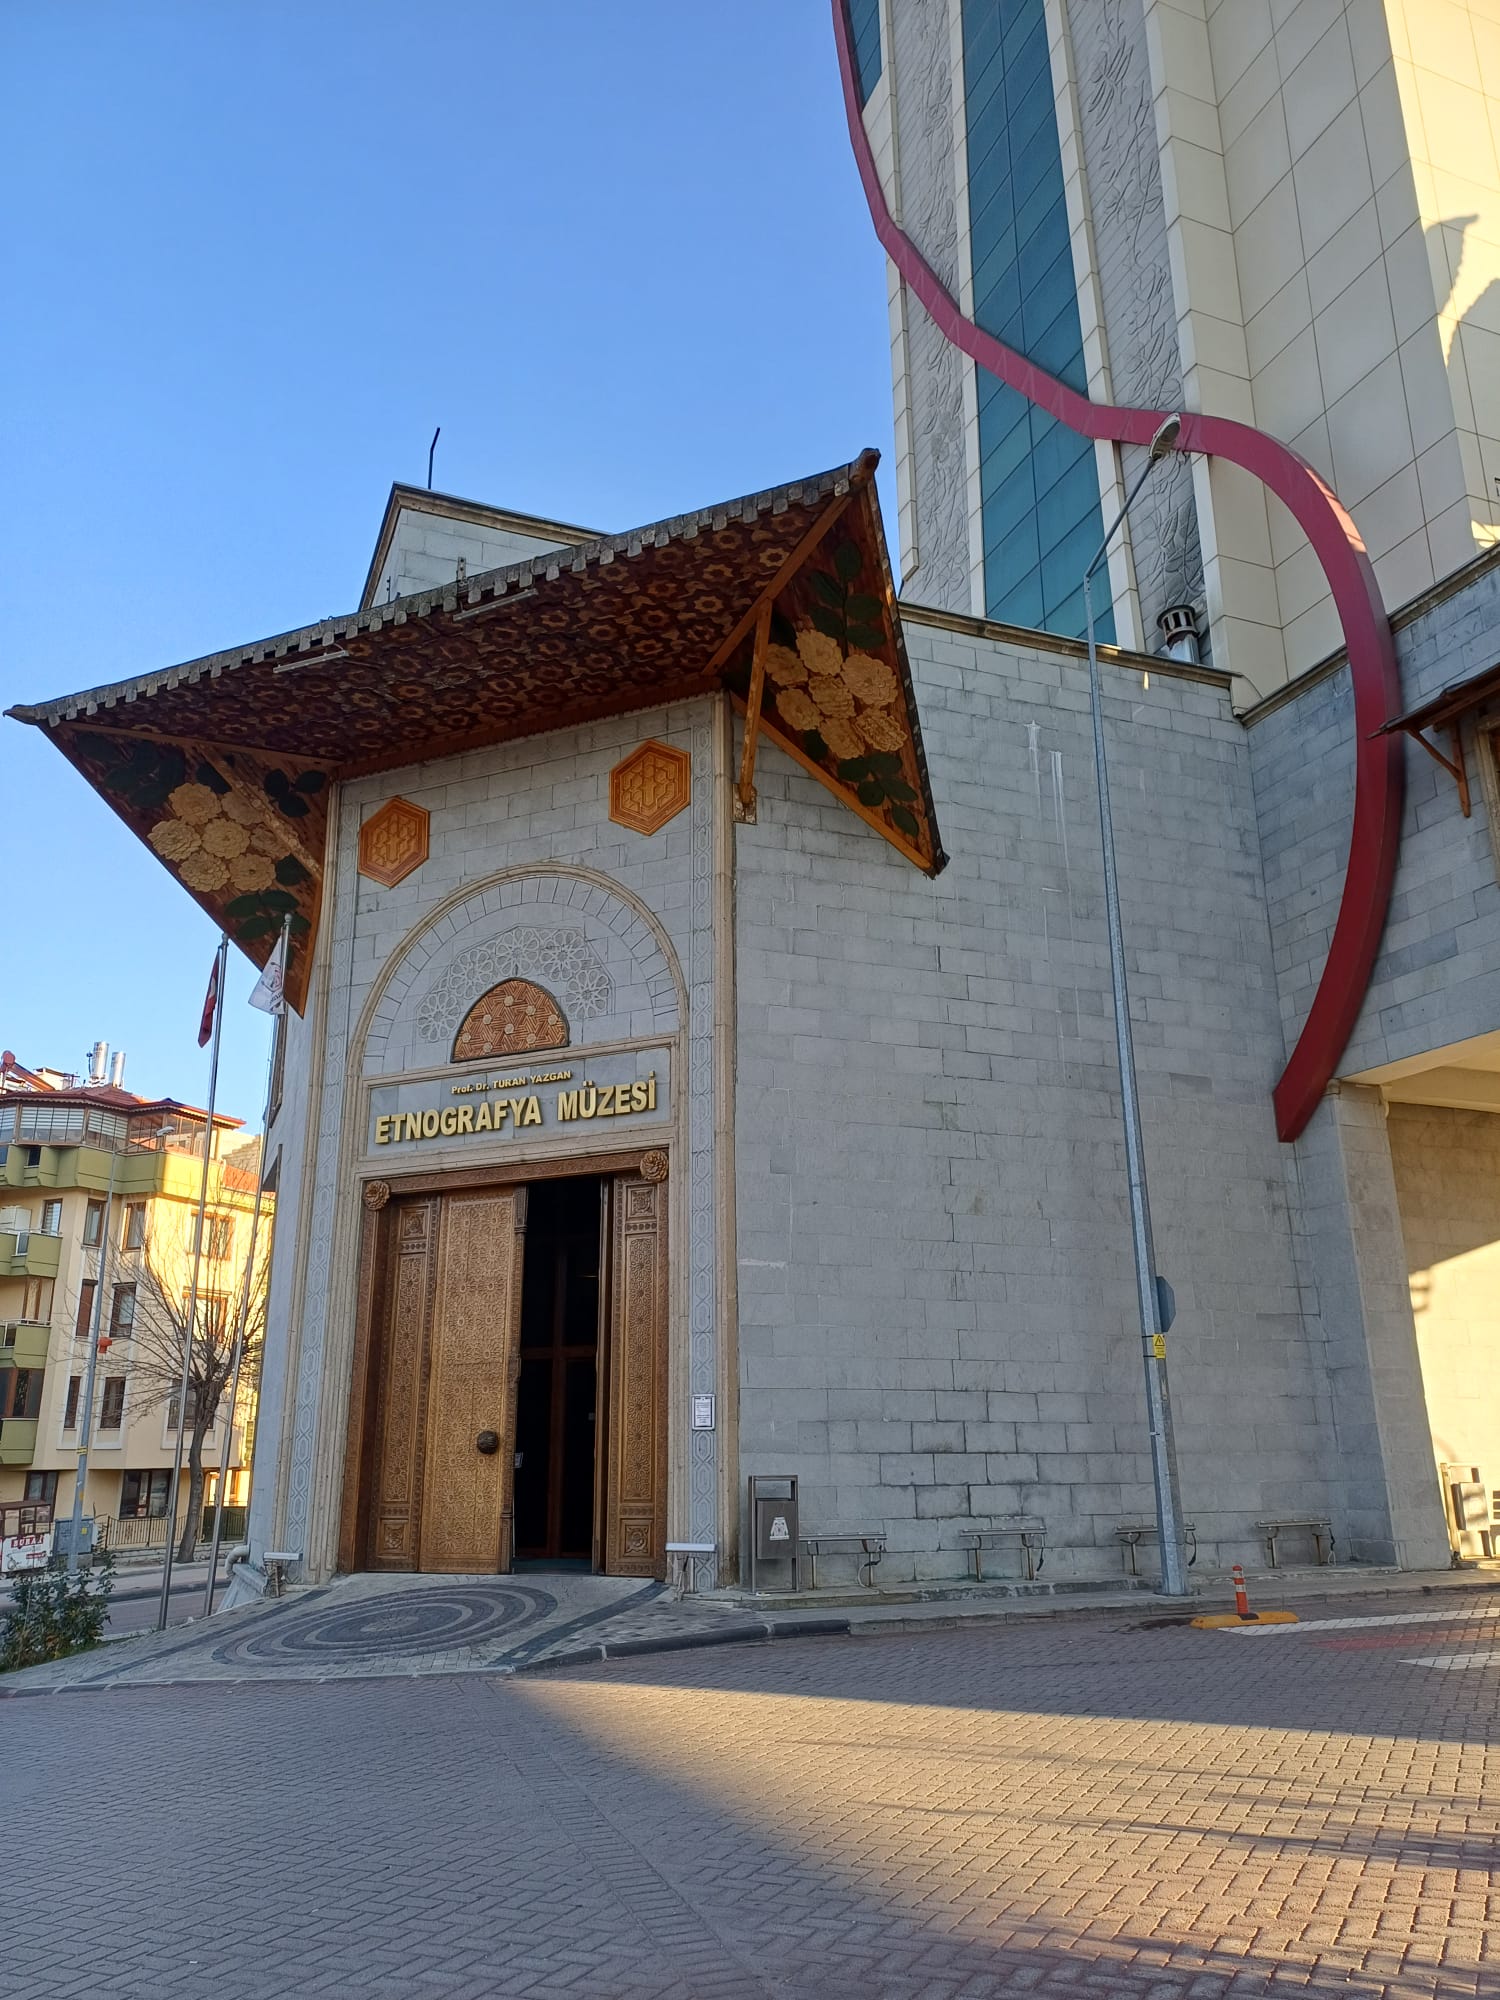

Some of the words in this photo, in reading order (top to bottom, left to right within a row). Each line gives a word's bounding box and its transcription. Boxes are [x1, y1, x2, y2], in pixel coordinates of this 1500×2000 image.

[451, 1085, 473, 1095] Prof.
[475, 1082, 490, 1092] Dr.
[493, 1076, 527, 1090] TURAN
[530, 1070, 572, 1085] YAZGAN
[375, 1095, 542, 1144] ETNOGRAFYA
[557, 1071, 656, 1121] MÜZESİ
